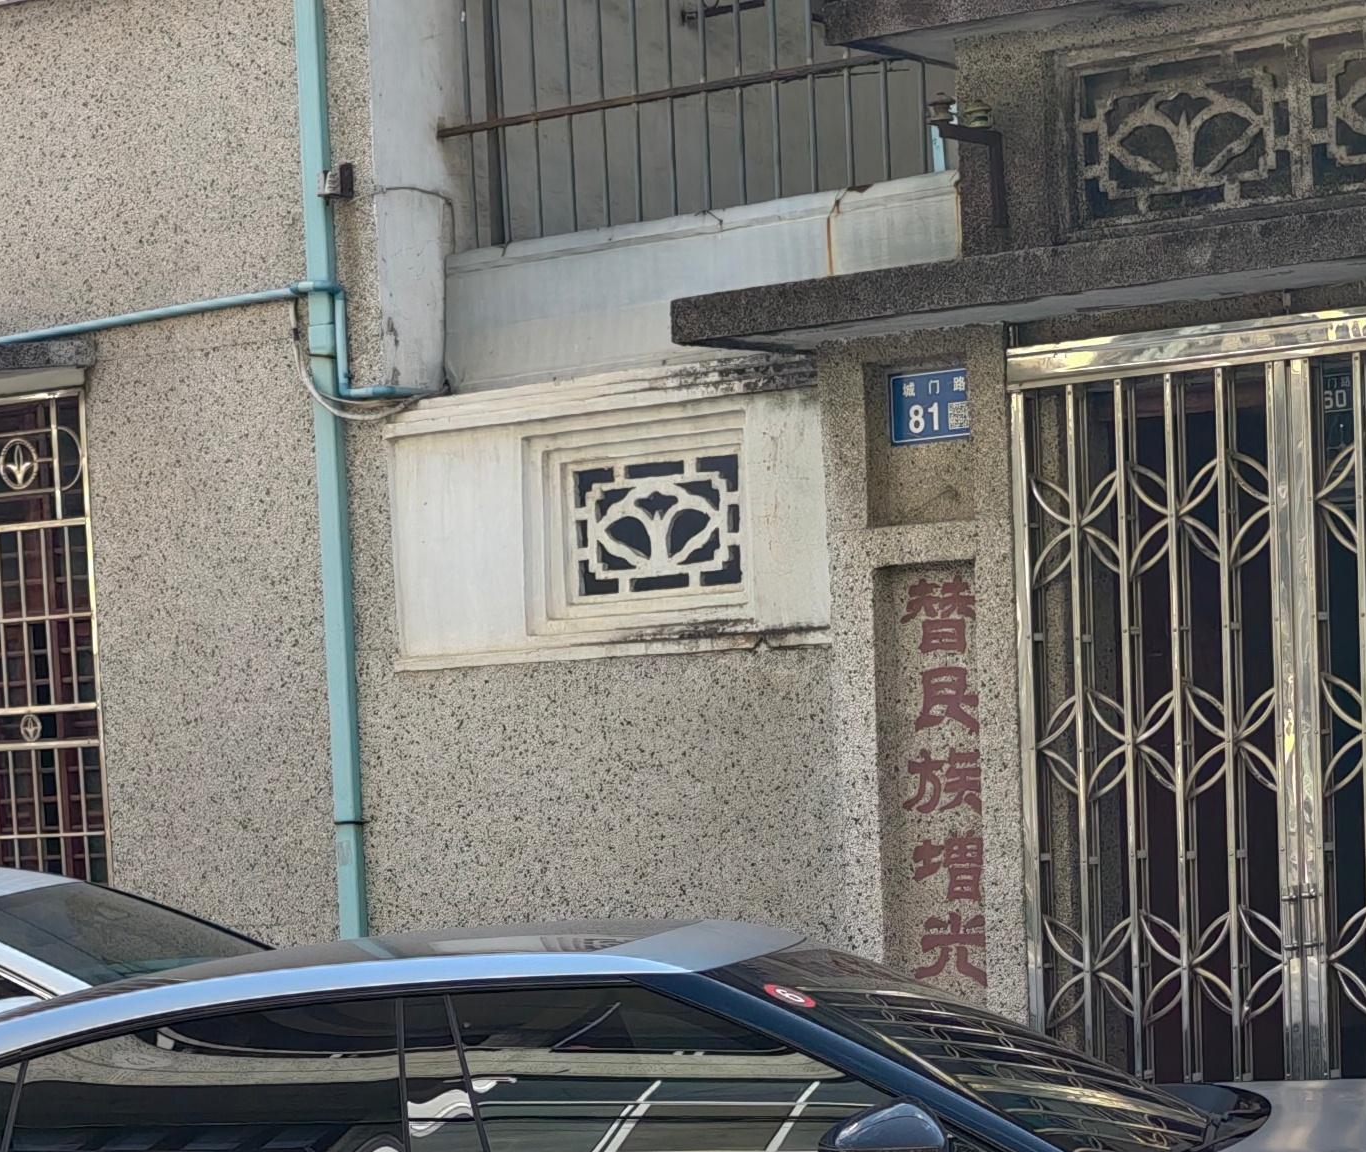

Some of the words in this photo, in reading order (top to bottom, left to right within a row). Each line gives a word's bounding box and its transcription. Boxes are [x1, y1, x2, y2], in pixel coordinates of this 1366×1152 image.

[902, 376, 966, 398] 城门路
[1324, 389, 1347, 409] 60
[908, 402, 939, 434] 81
[901, 574, 988, 988] 替民族增光
